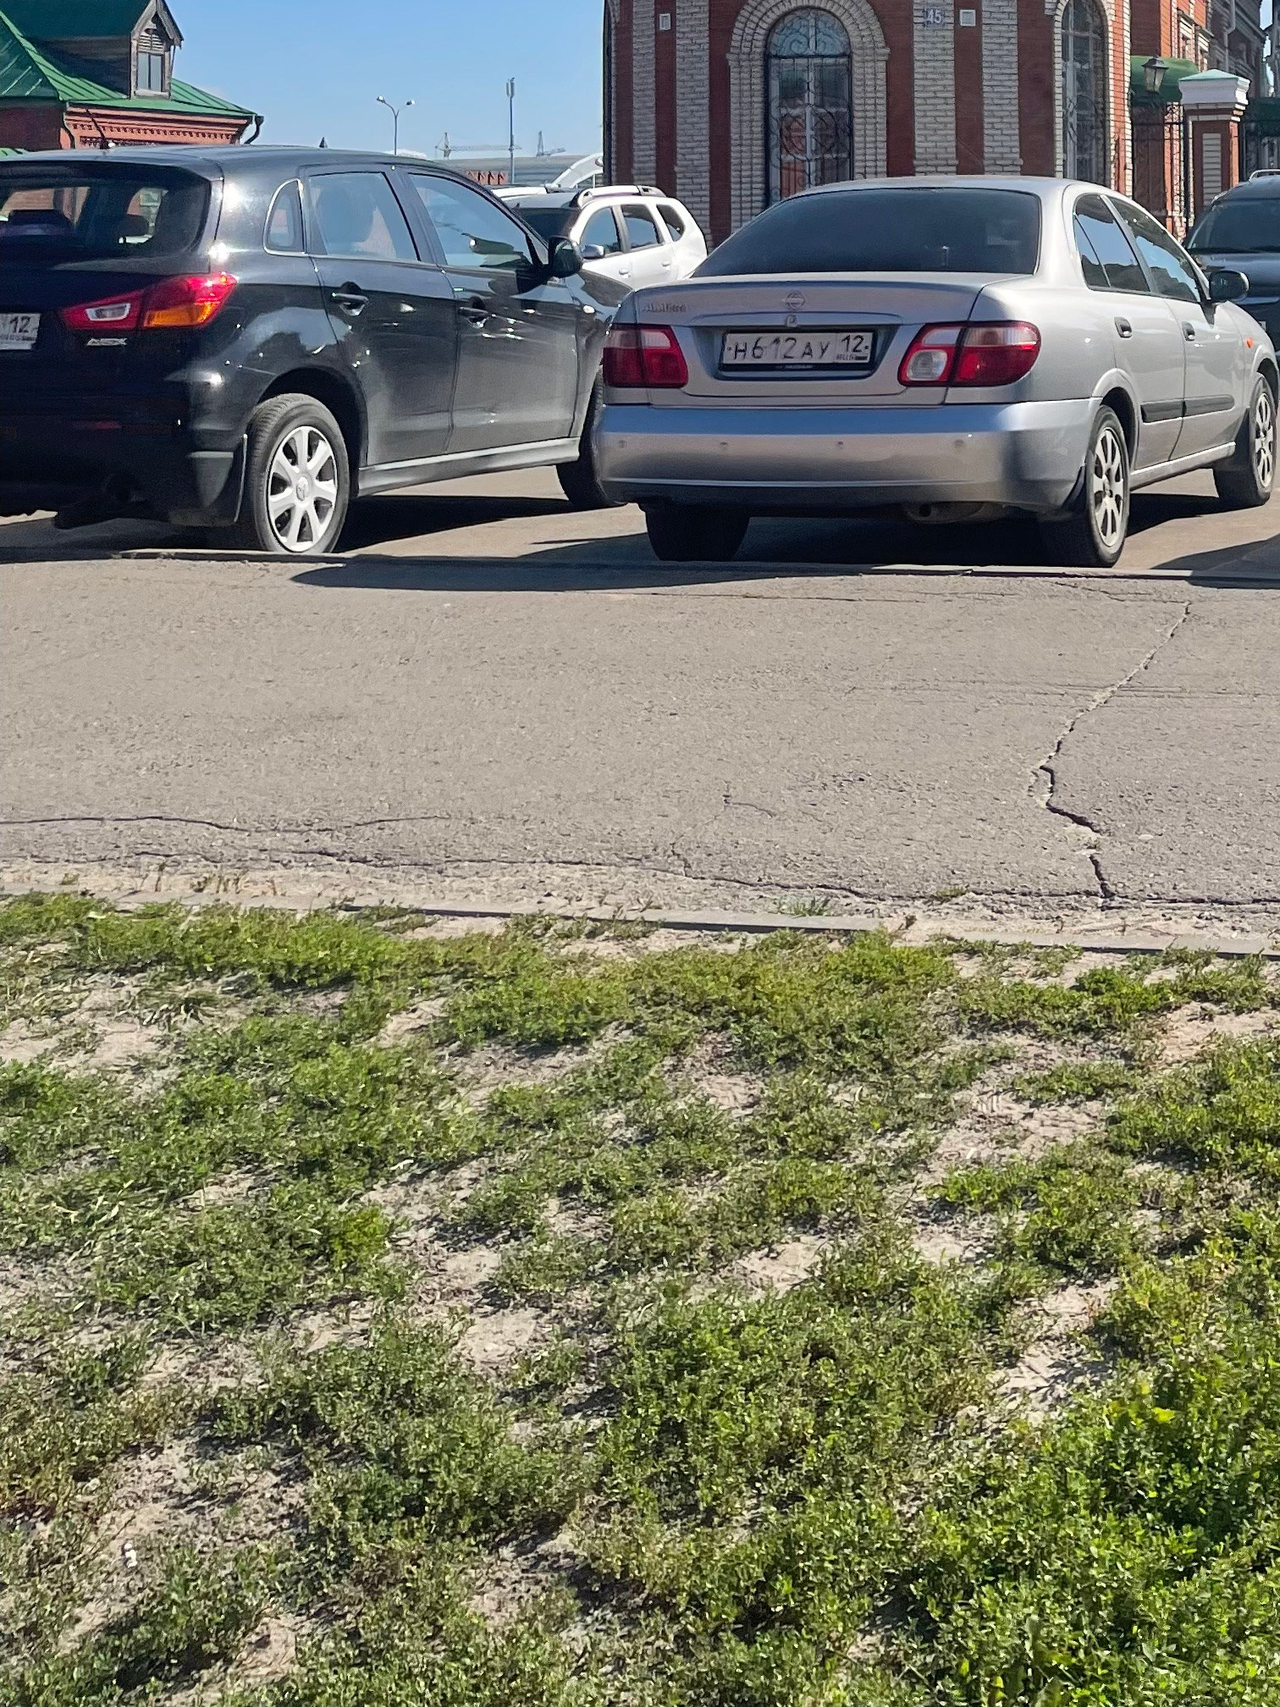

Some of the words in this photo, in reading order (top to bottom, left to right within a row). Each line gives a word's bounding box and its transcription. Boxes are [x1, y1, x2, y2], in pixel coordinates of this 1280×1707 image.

[926, 8, 942, 24] 45
[9, 315, 31, 334] 12
[841, 334, 865, 353] 12
